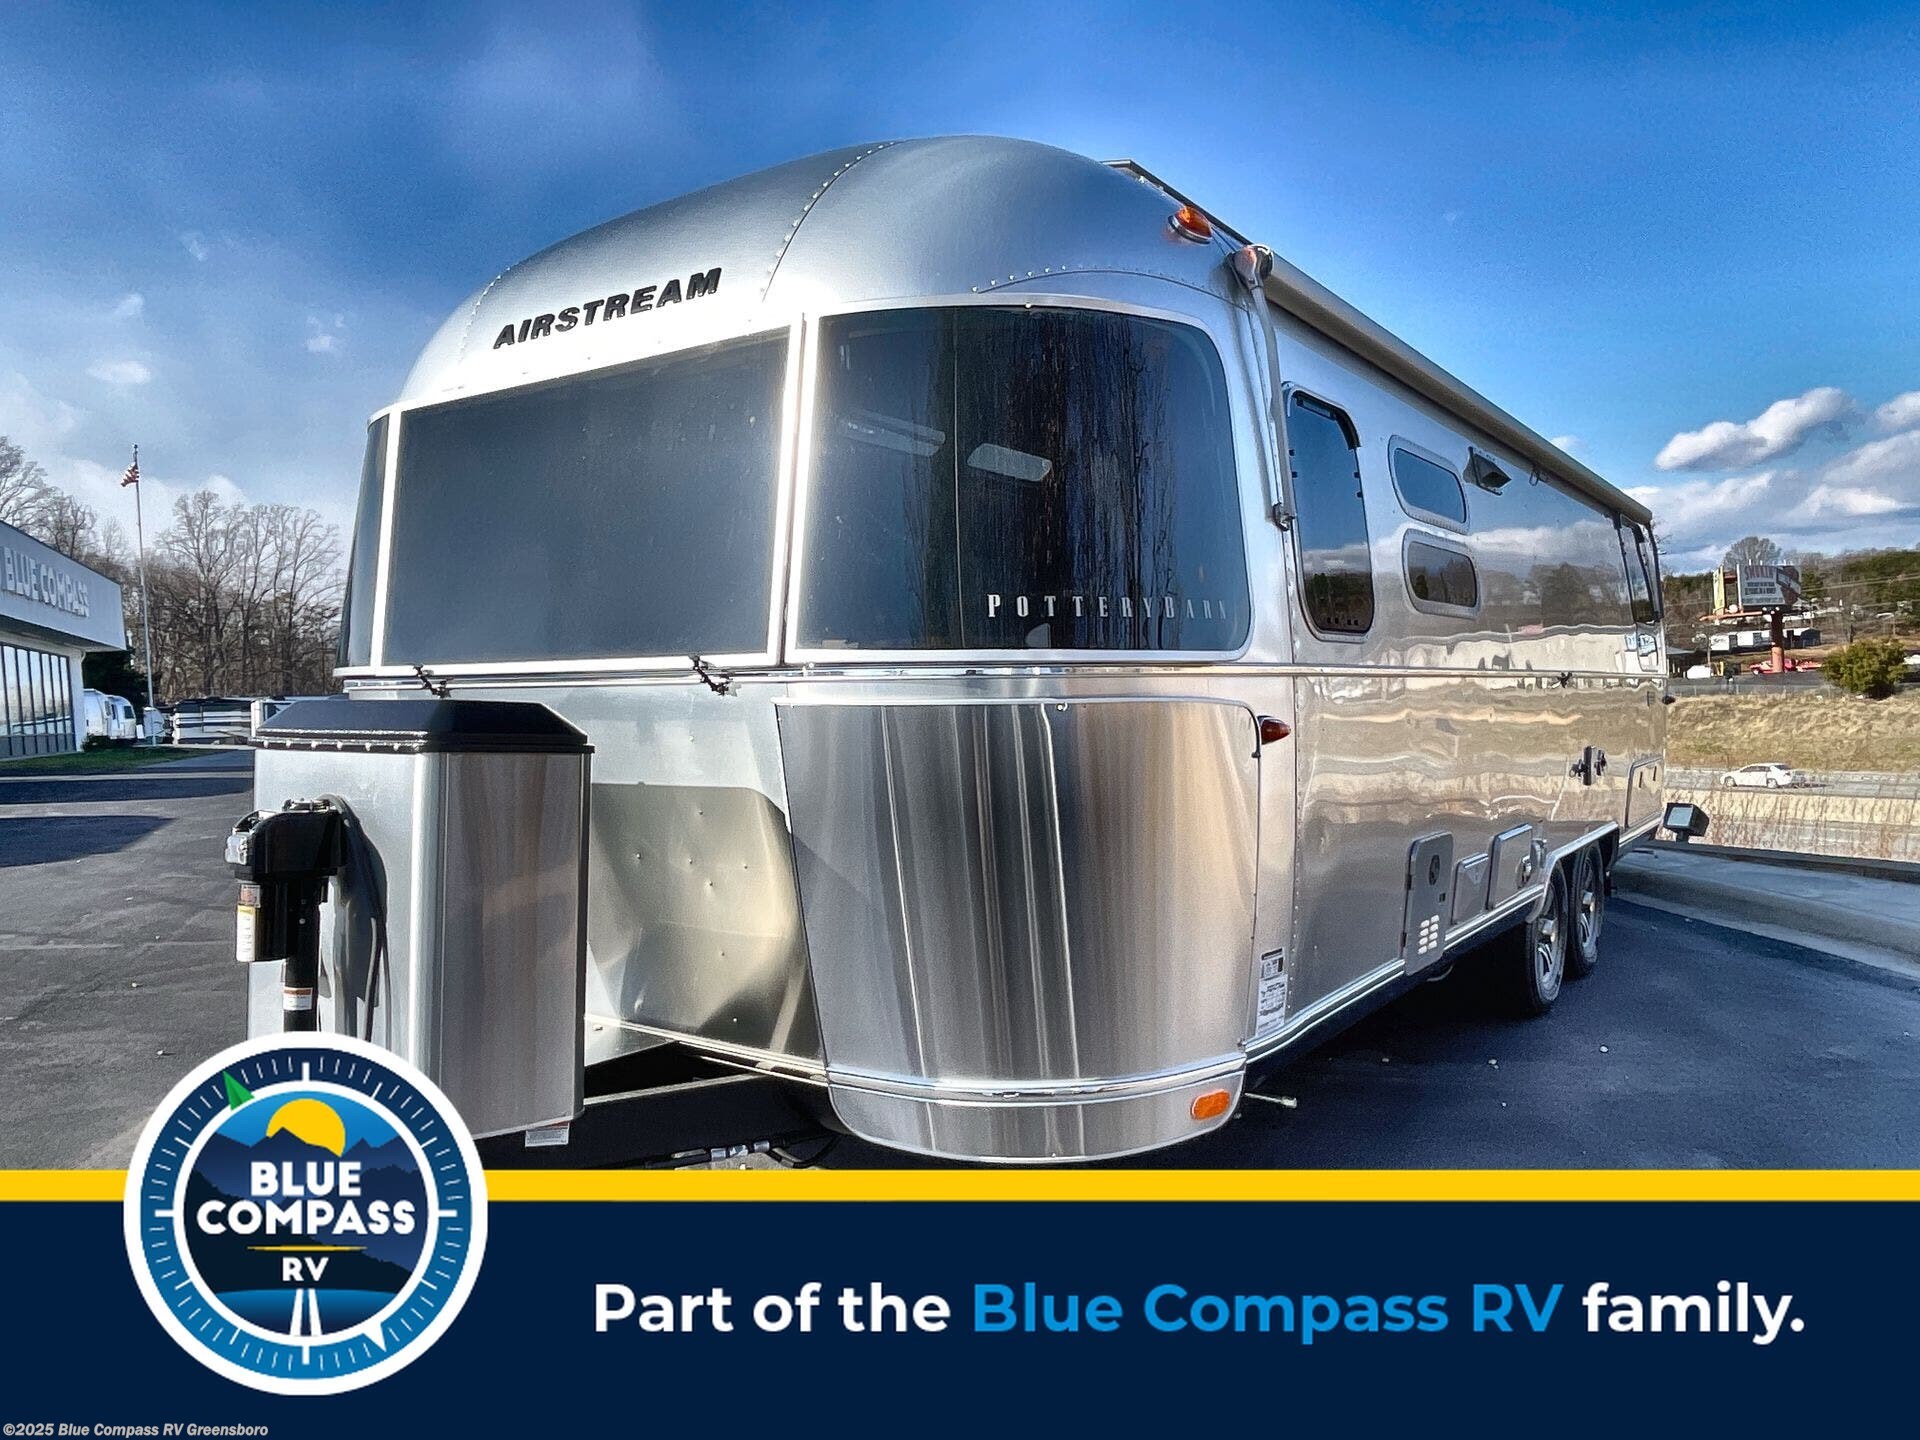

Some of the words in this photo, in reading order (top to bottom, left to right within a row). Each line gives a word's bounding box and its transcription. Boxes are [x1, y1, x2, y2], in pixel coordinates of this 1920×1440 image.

[493, 267, 722, 350] AIRSTREAM
[3, 545, 39, 600] BLUE
[41, 563, 89, 618] COMPASS
